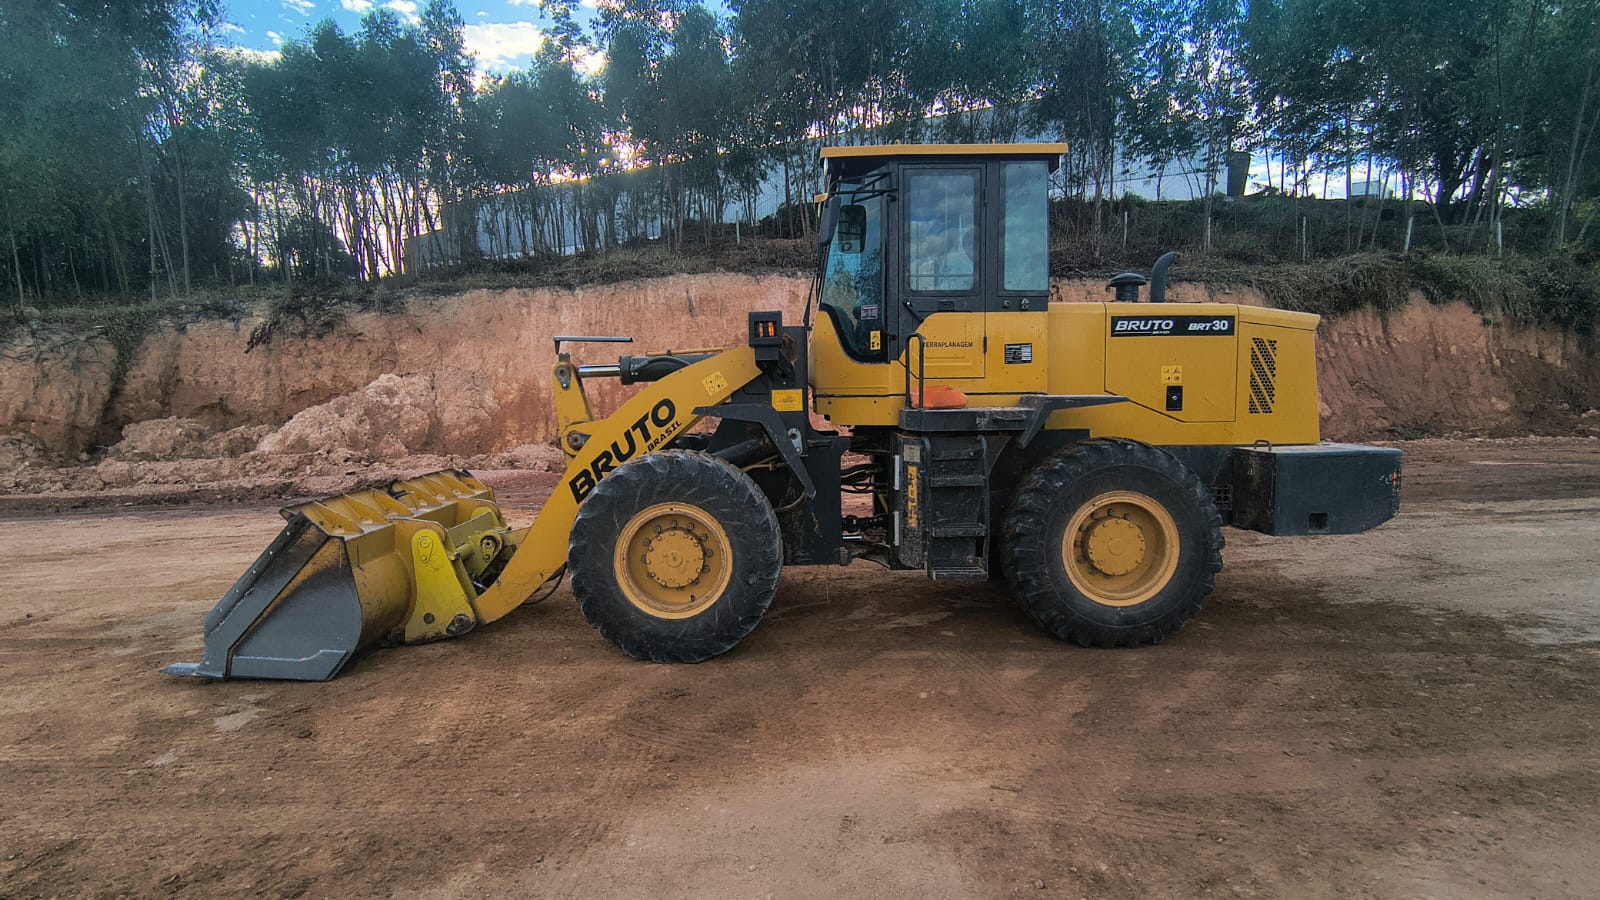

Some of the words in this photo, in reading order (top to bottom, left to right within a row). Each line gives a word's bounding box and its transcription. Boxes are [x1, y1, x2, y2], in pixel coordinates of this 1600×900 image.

[1114, 319, 1174, 331] BRUTO
[568, 398, 677, 504] BRUTO
[647, 420, 682, 452] BRASIL
